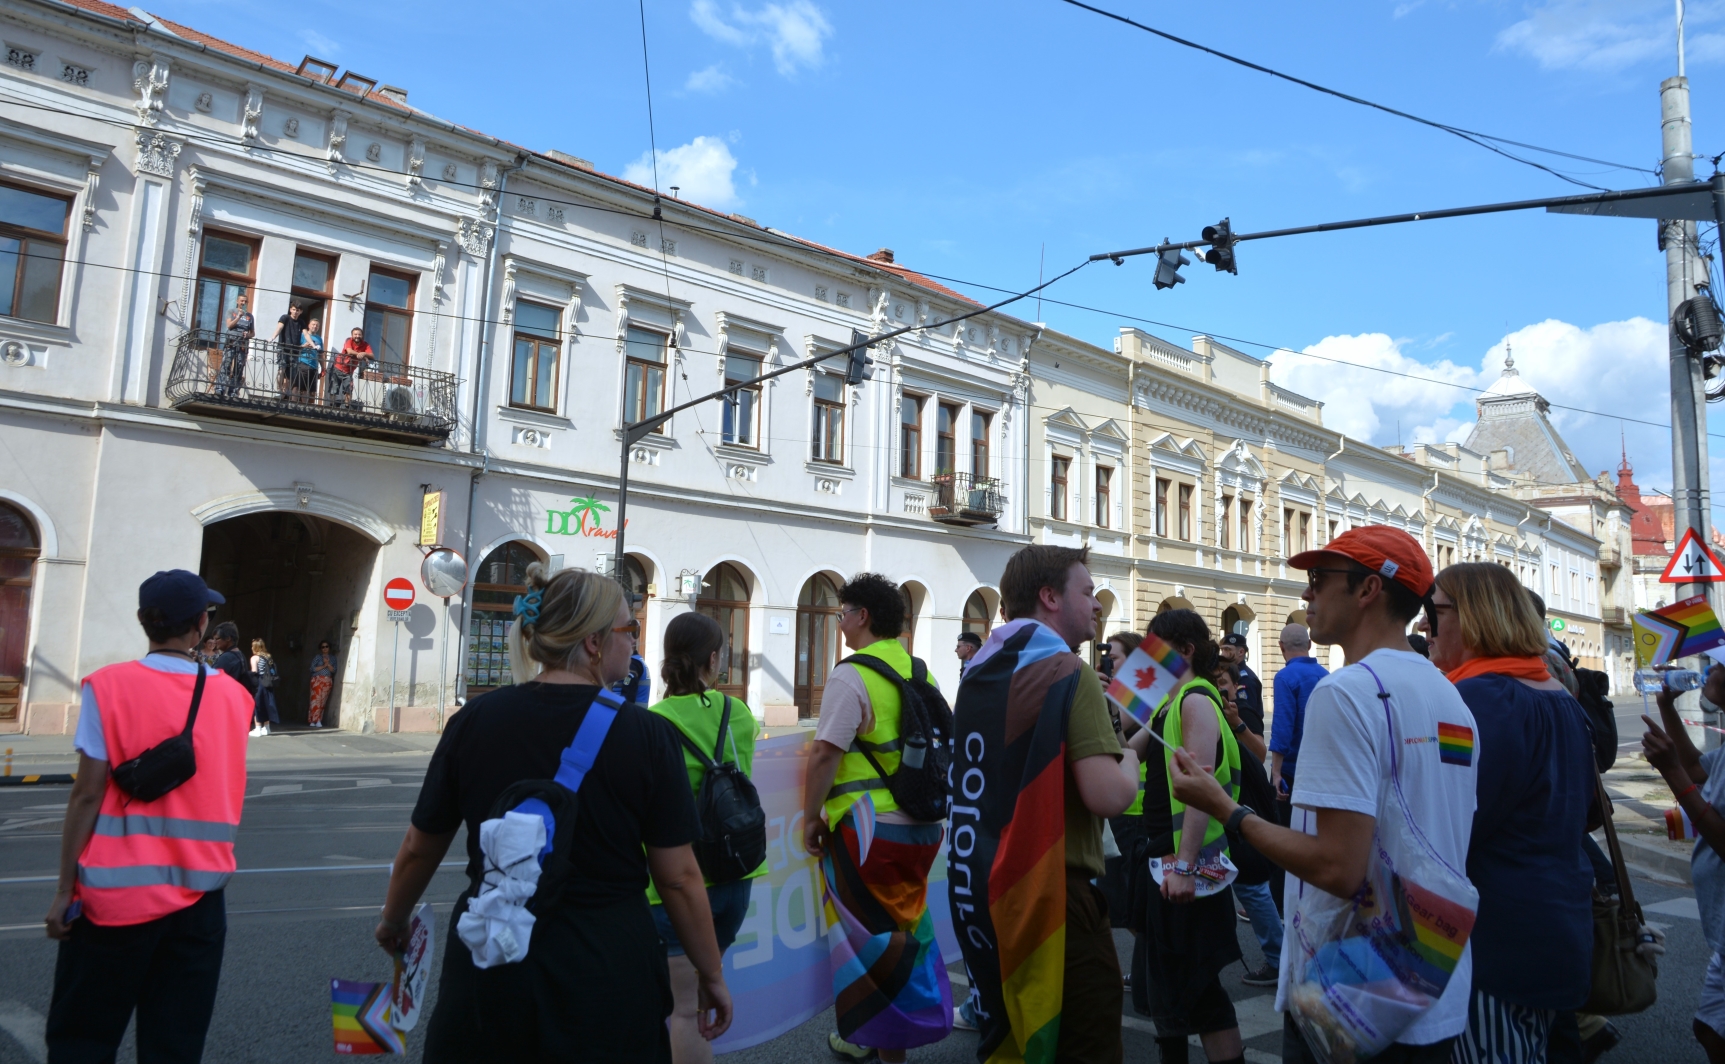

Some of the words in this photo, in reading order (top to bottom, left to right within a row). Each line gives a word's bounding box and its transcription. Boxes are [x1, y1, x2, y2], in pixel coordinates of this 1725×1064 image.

[1355, 922, 1371, 939] de
[1383, 911, 1424, 964] Marathon
[1407, 894, 1434, 921] Gear
[1434, 912, 1459, 939] bag
